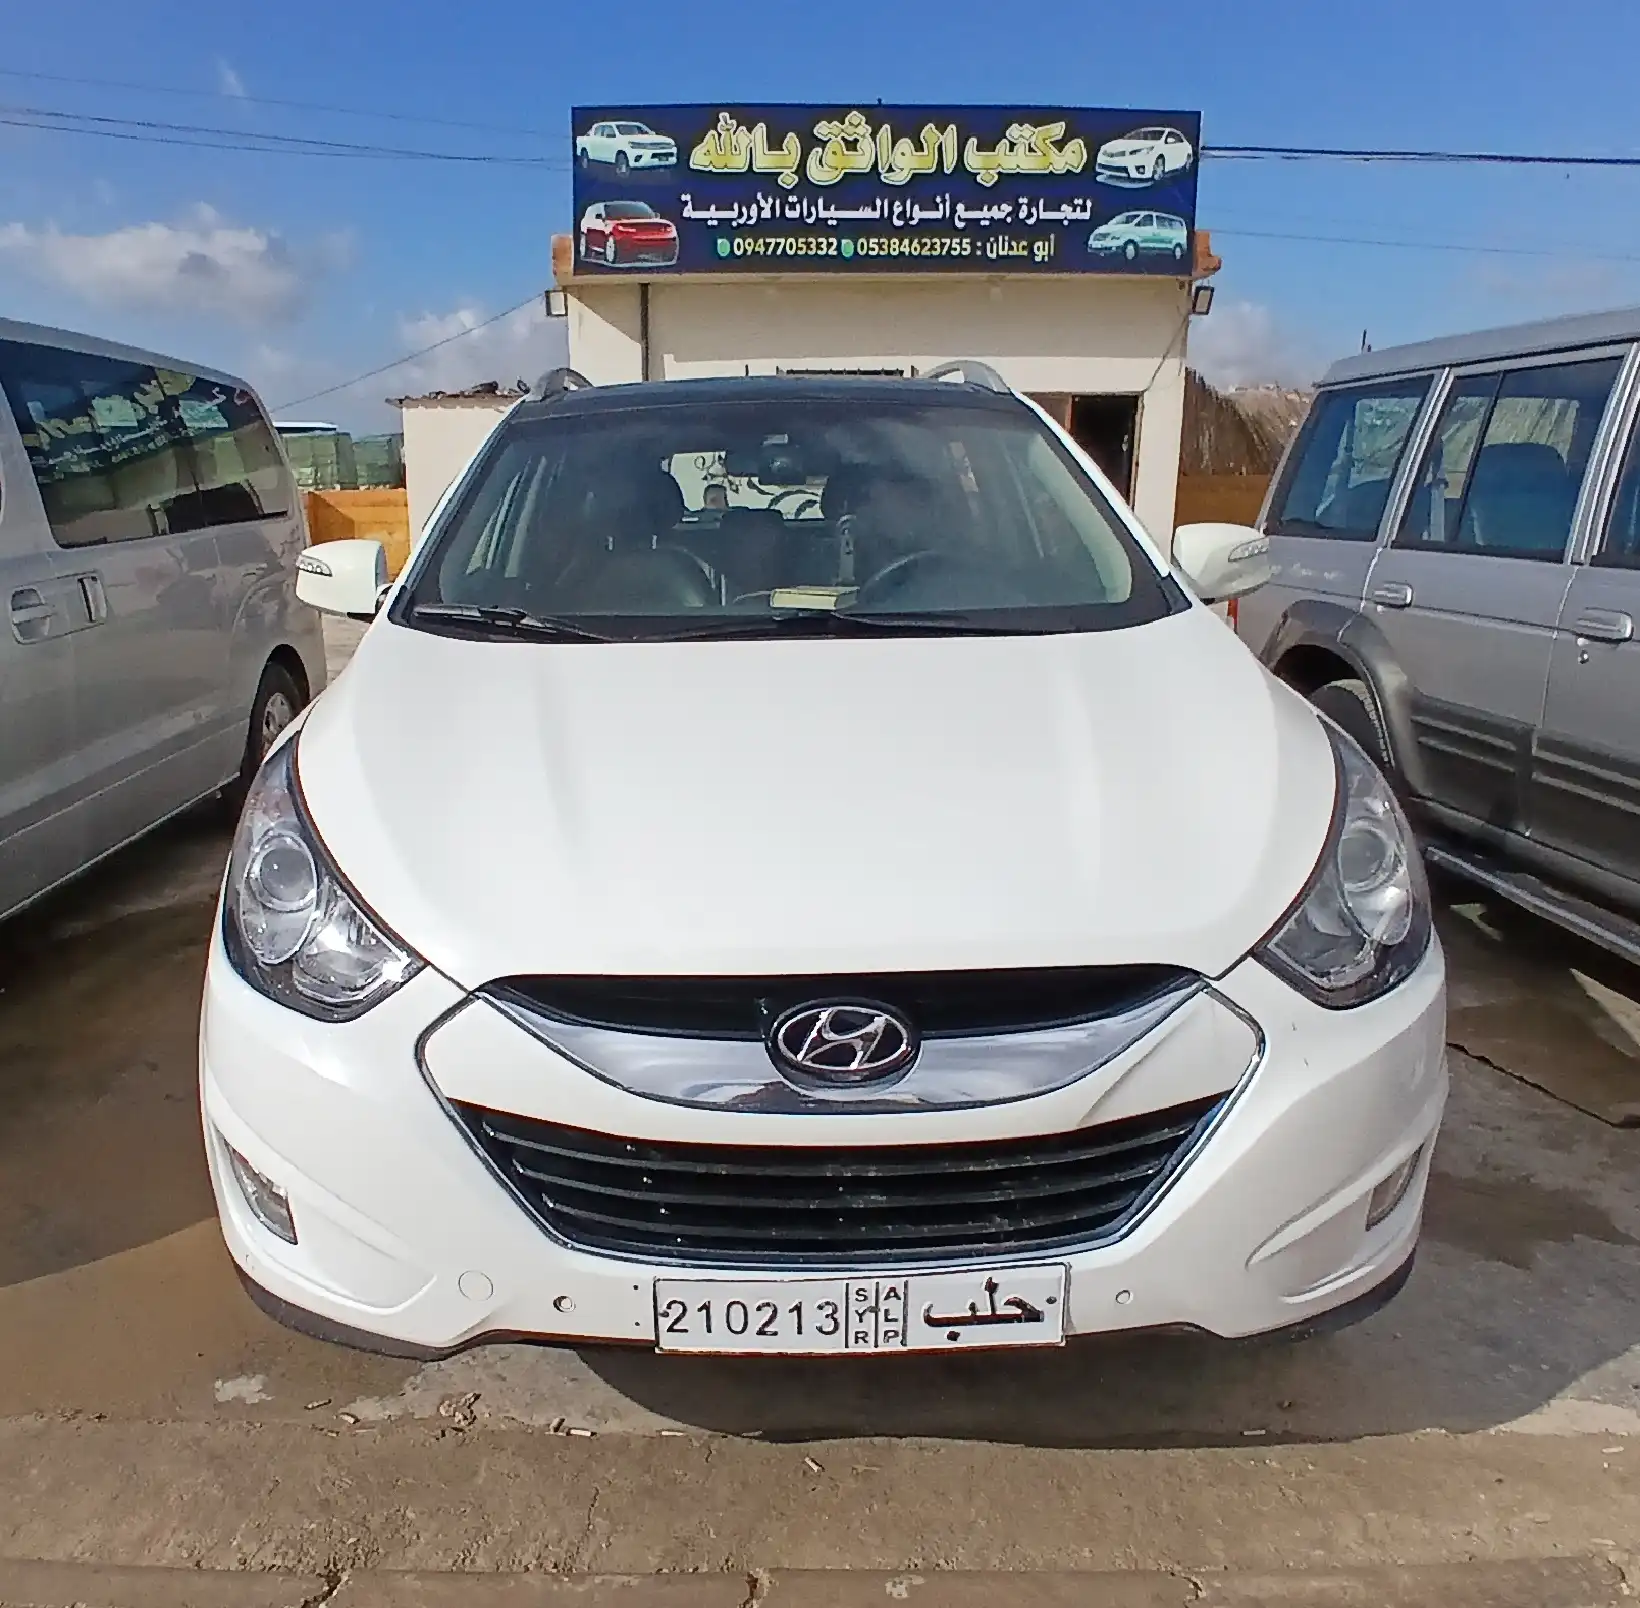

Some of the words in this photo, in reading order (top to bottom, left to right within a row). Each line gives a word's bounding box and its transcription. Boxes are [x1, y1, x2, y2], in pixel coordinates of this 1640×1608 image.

[689, 111, 802, 190] بالله
[806, 110, 958, 186] الواثق
[964, 121, 1088, 187] مكتب
[680, 191, 782, 227] الأوربية
[784, 195, 890, 226] السيارات
[892, 192, 951, 227] أنواع
[954, 202, 1014, 230] جميع
[1018, 197, 1093, 226] لتجارة
[733, 236, 838, 257] 0947705332
[856, 236, 972, 257] 05384623755
[986, 234, 1029, 260] عدنان
[666, 1299, 840, 1336] 210213
[854, 1287, 869, 1344] SYR
[883, 1286, 901, 1343] ALP
[922, 1277, 1044, 1342] حلب
